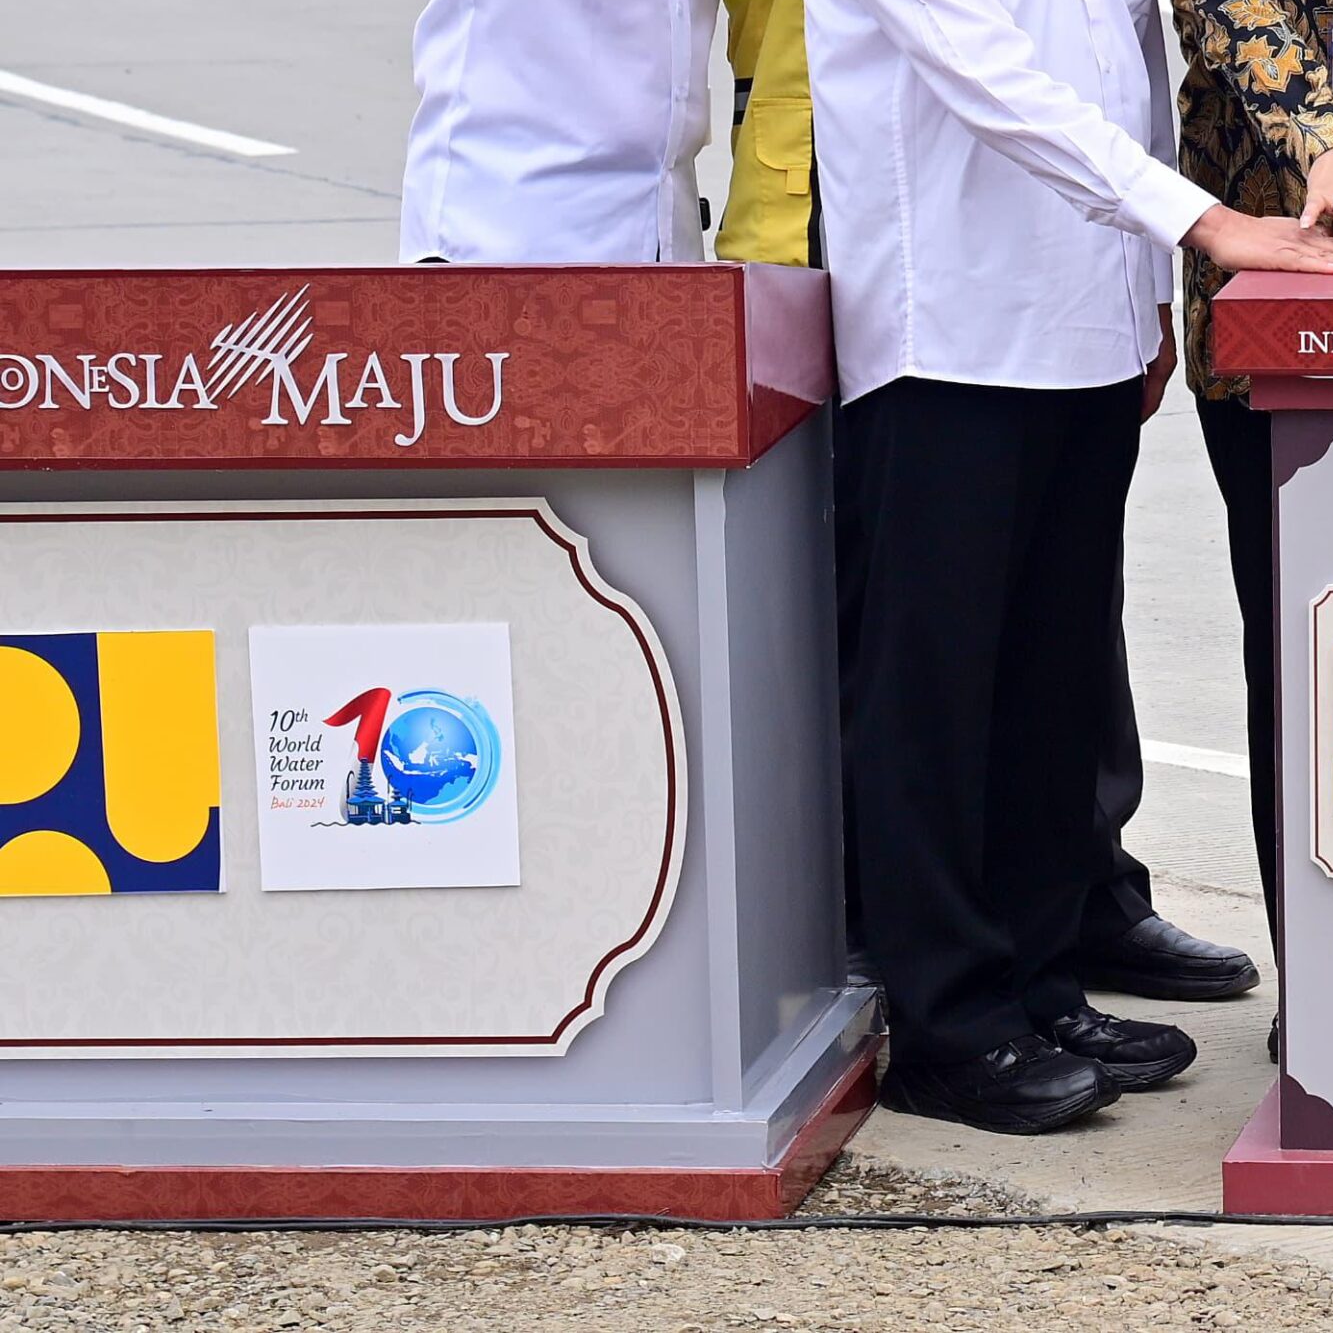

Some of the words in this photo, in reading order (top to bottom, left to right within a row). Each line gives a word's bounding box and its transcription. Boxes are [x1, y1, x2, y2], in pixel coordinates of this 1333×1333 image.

[261, 351, 510, 447] MAJU
[269, 708, 309, 732] 10th
[268, 733, 323, 753] World
[269, 755, 324, 772] Water
[270, 774, 325, 791] Forum
[271, 796, 294, 809] Bali
[296, 796, 326, 809] 2024
